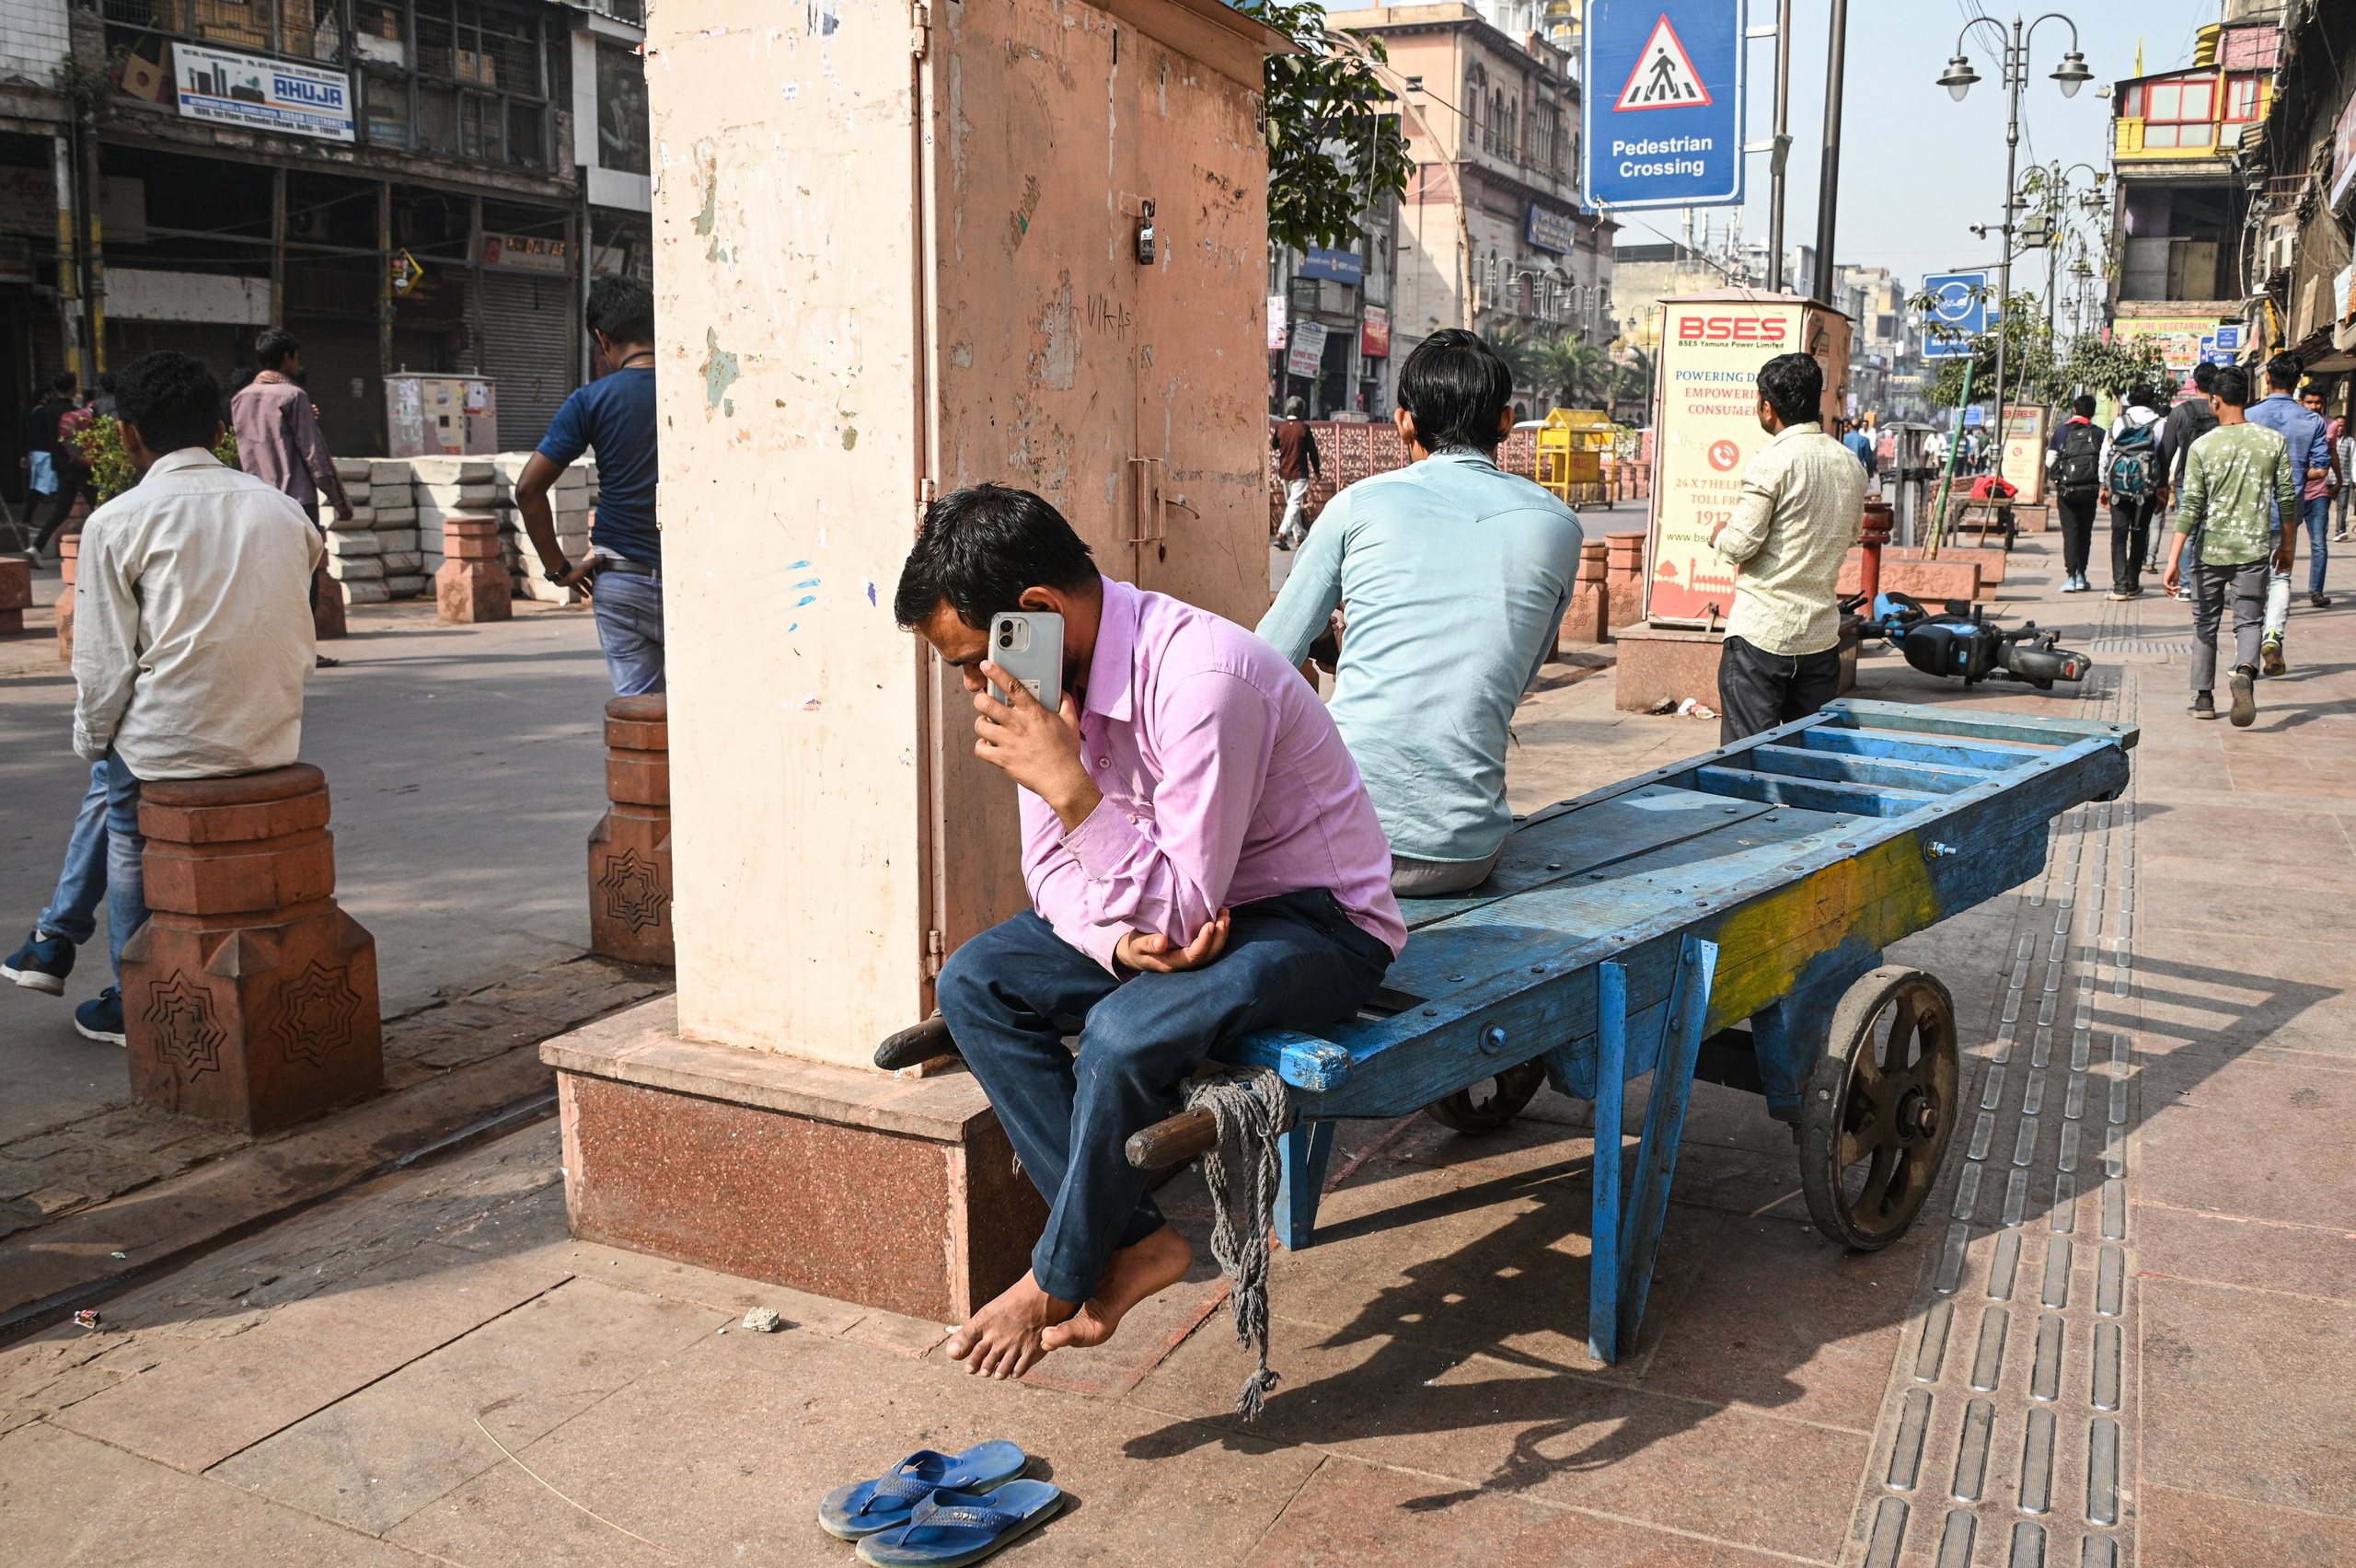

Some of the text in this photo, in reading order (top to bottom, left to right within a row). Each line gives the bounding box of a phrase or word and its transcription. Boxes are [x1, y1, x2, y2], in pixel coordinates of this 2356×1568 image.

[273, 79, 342, 106] AHUJA
[1612, 135, 1713, 156] Pedestrian
[1620, 157, 1704, 178] Crossing
[1679, 317, 1787, 340] BSES
[2135, 322, 2156, 331] PURE
[2158, 322, 2209, 331] VEGETARIAN
[1675, 370, 1744, 383] POWERING
[1675, 478, 1689, 488] 24
[1691, 478, 1699, 489] X
[1701, 479, 1707, 489] 7
[1690, 493, 1719, 505] TOLL
